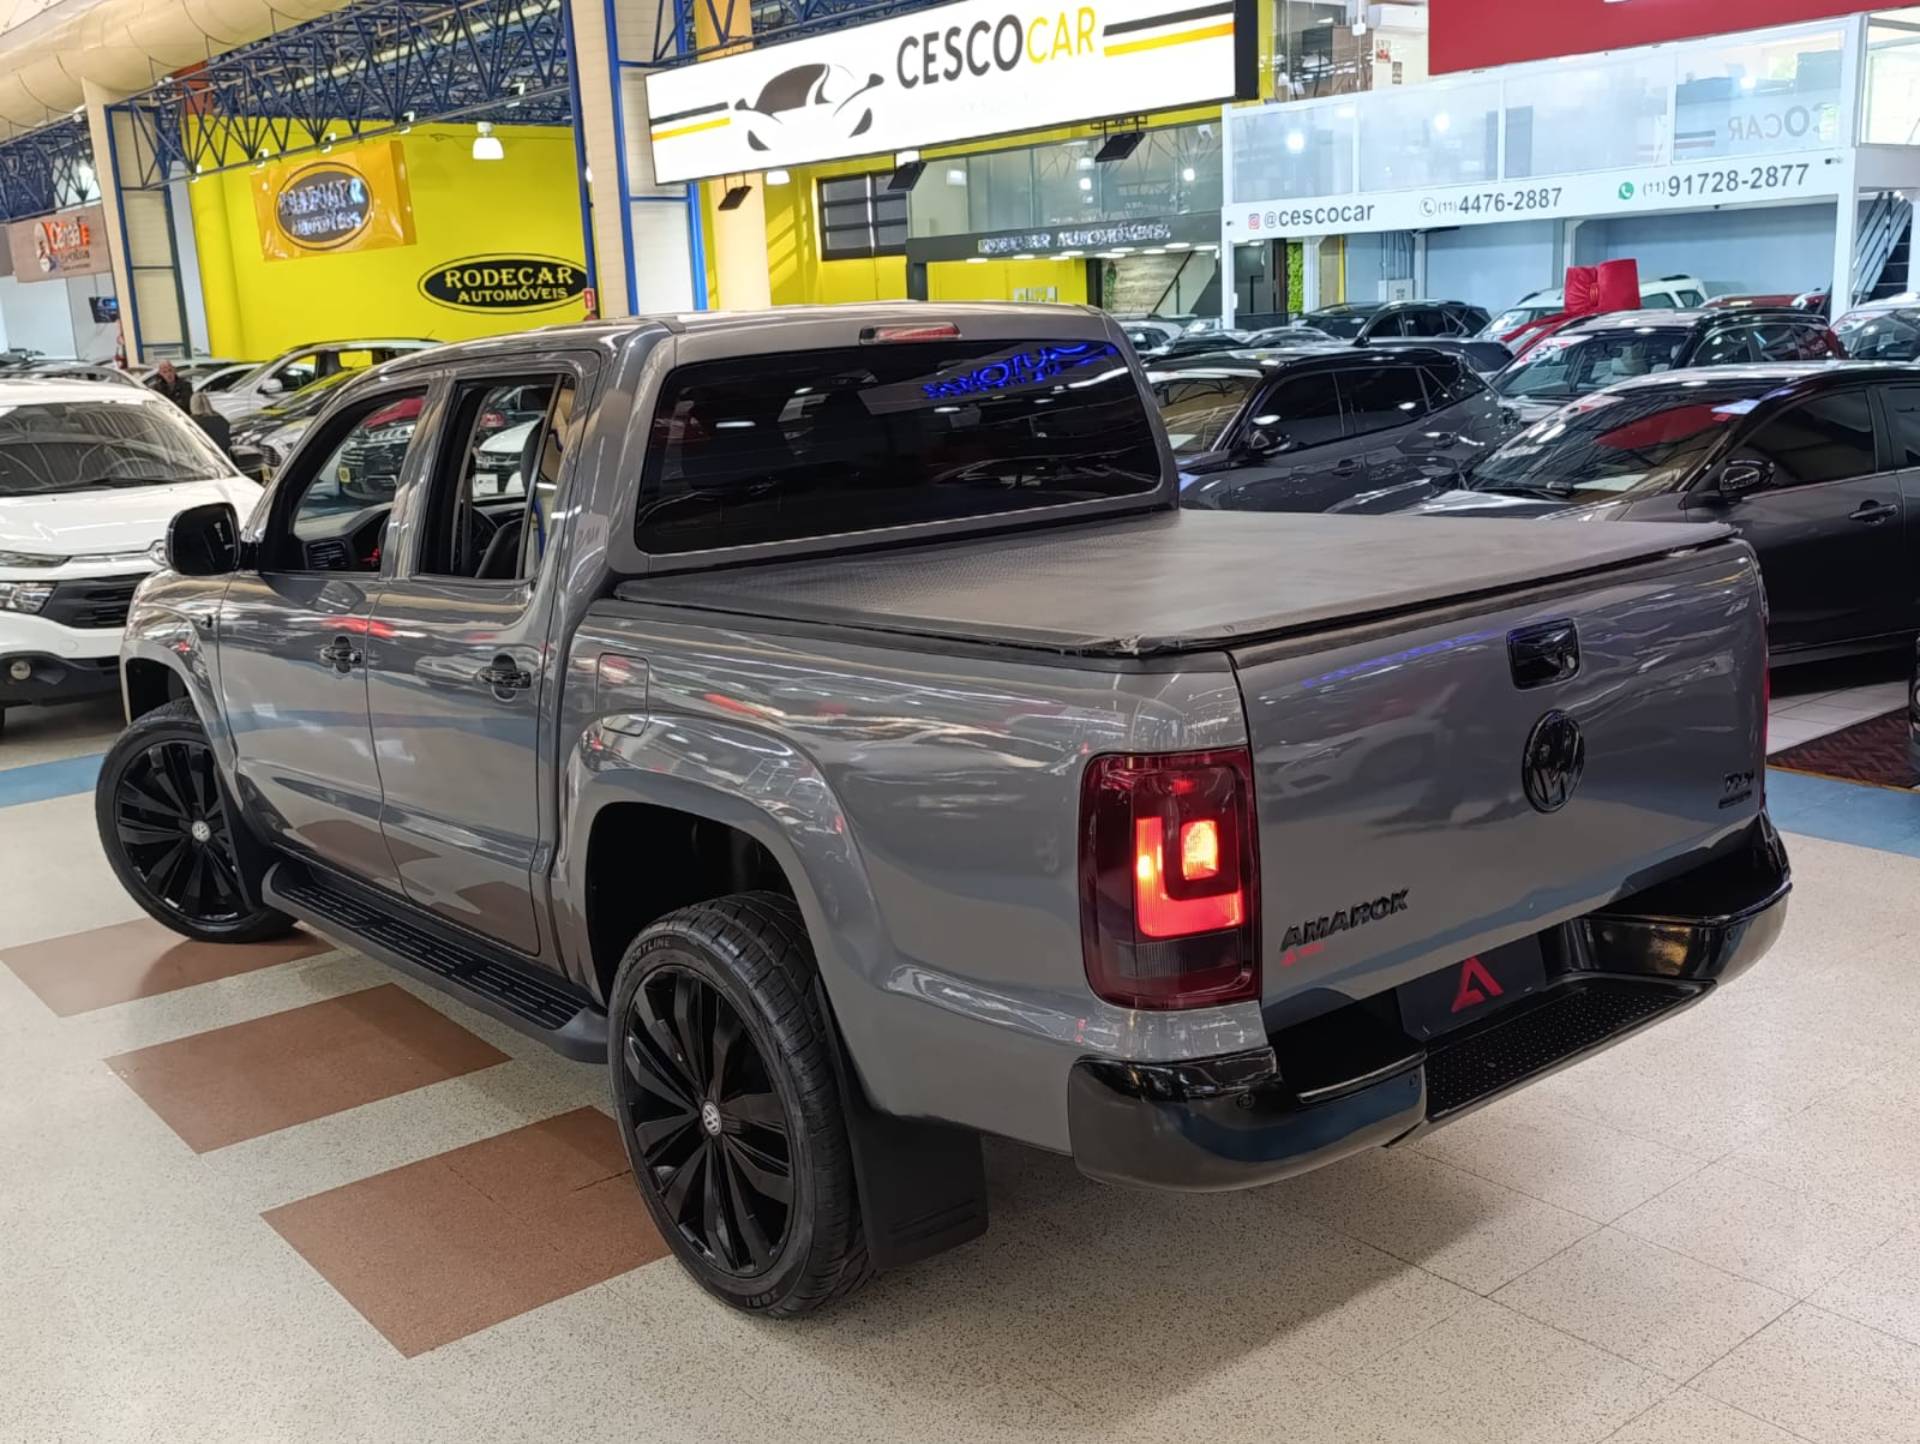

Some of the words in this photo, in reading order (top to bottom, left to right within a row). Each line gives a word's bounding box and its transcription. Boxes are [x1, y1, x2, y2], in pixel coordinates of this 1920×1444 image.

[896, 6, 1096, 89] CESCOCAR
[1264, 203, 1375, 228] @cescocar
[444, 266, 575, 289] RODECAR
[457, 286, 569, 304] AUTOMÓVEIS
[1280, 888, 1410, 951] AMAROK
